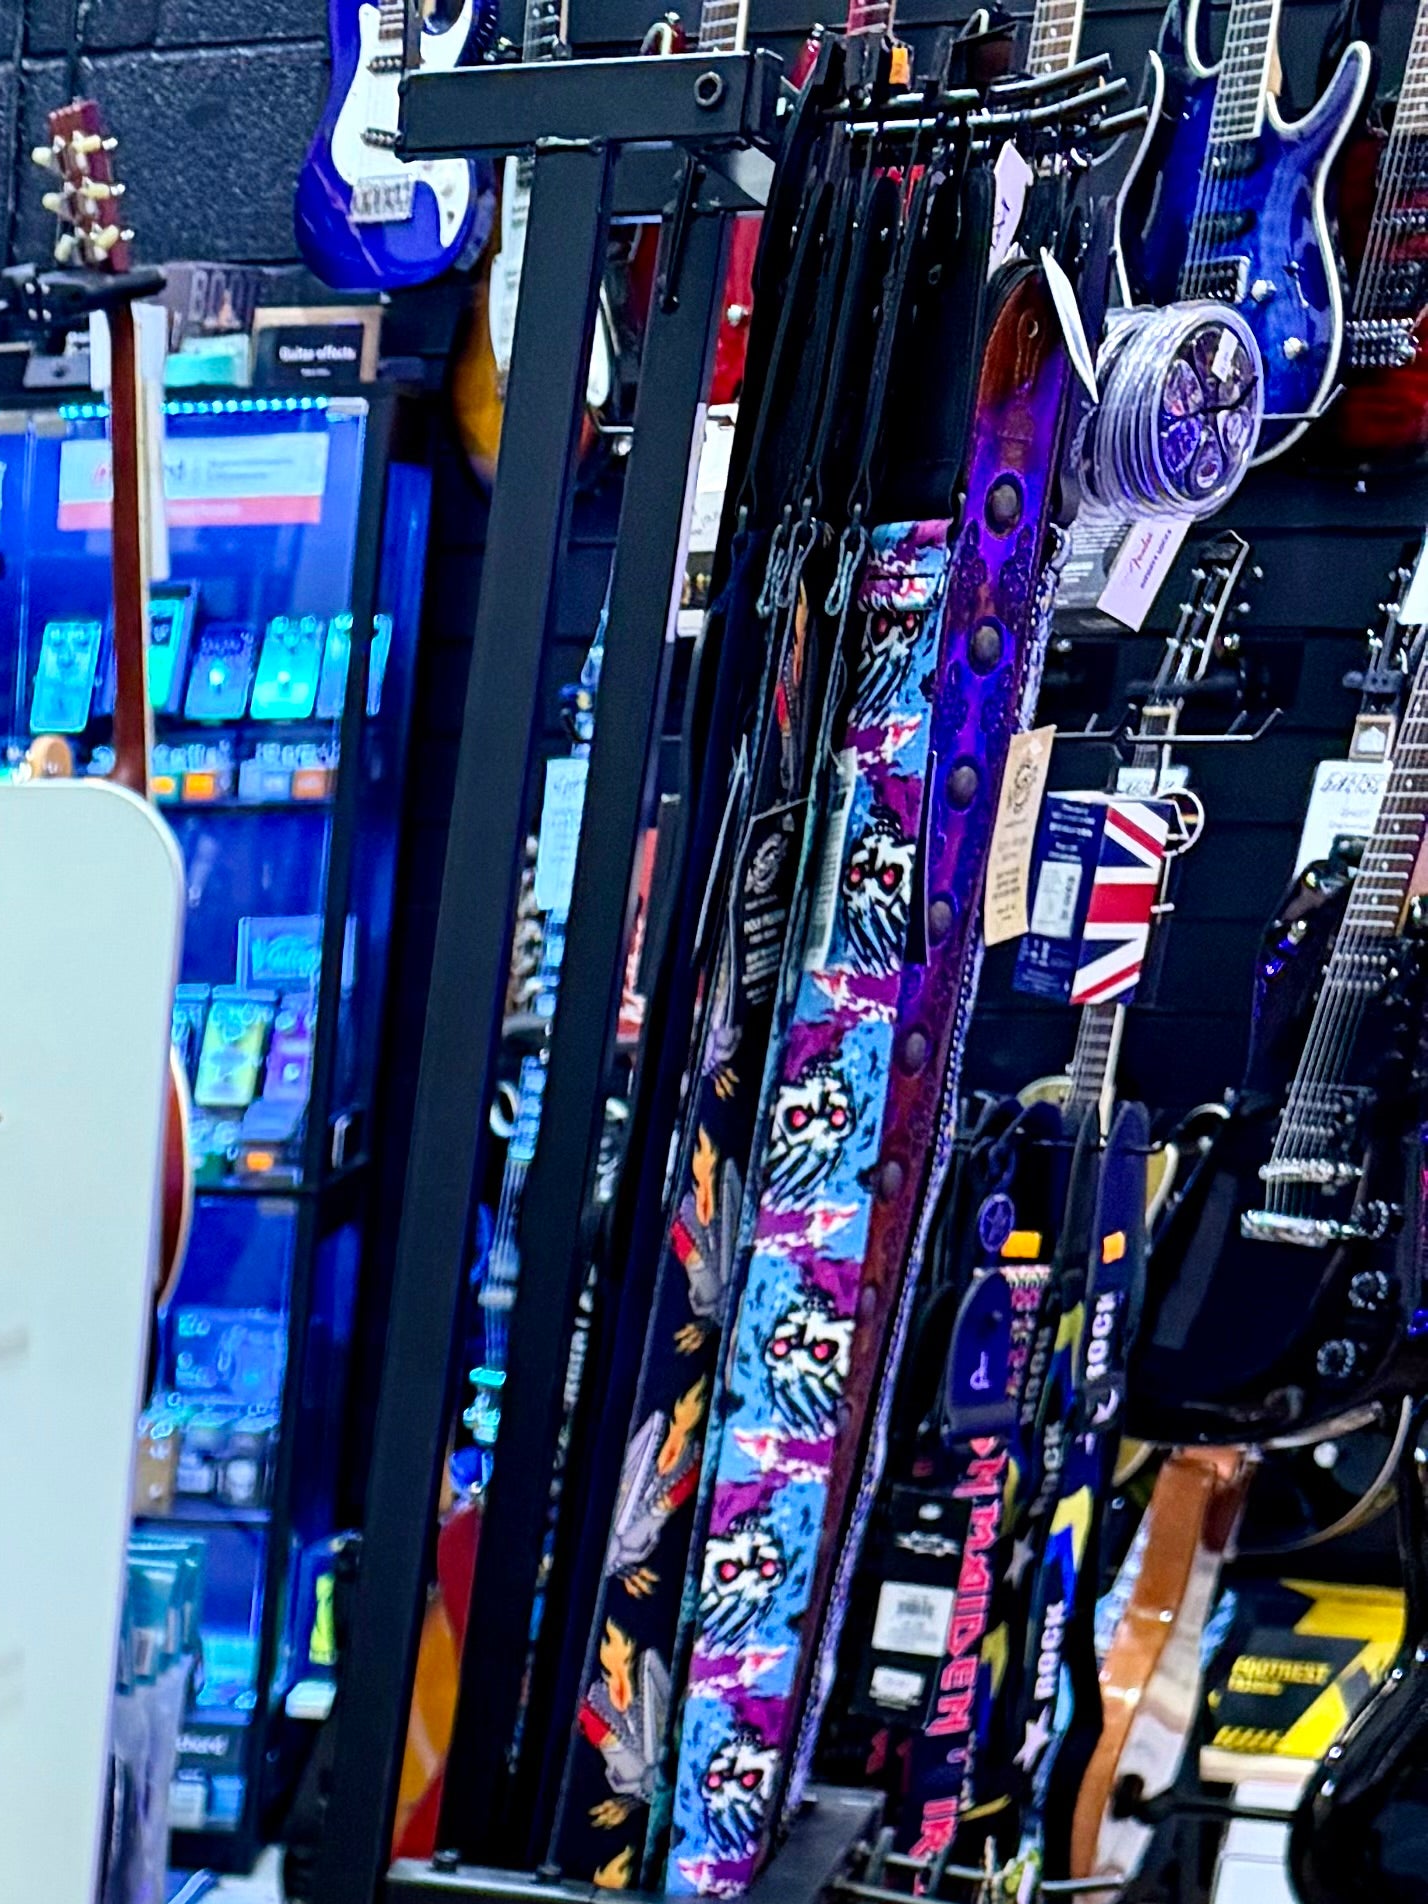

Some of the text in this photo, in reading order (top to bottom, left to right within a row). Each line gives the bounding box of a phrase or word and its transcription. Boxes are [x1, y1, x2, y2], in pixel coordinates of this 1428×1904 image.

[279, 344, 357, 363] Guitar effects
[925, 1498, 1004, 1738] MAIDEN
[1033, 1601, 1067, 1700] ROCK
